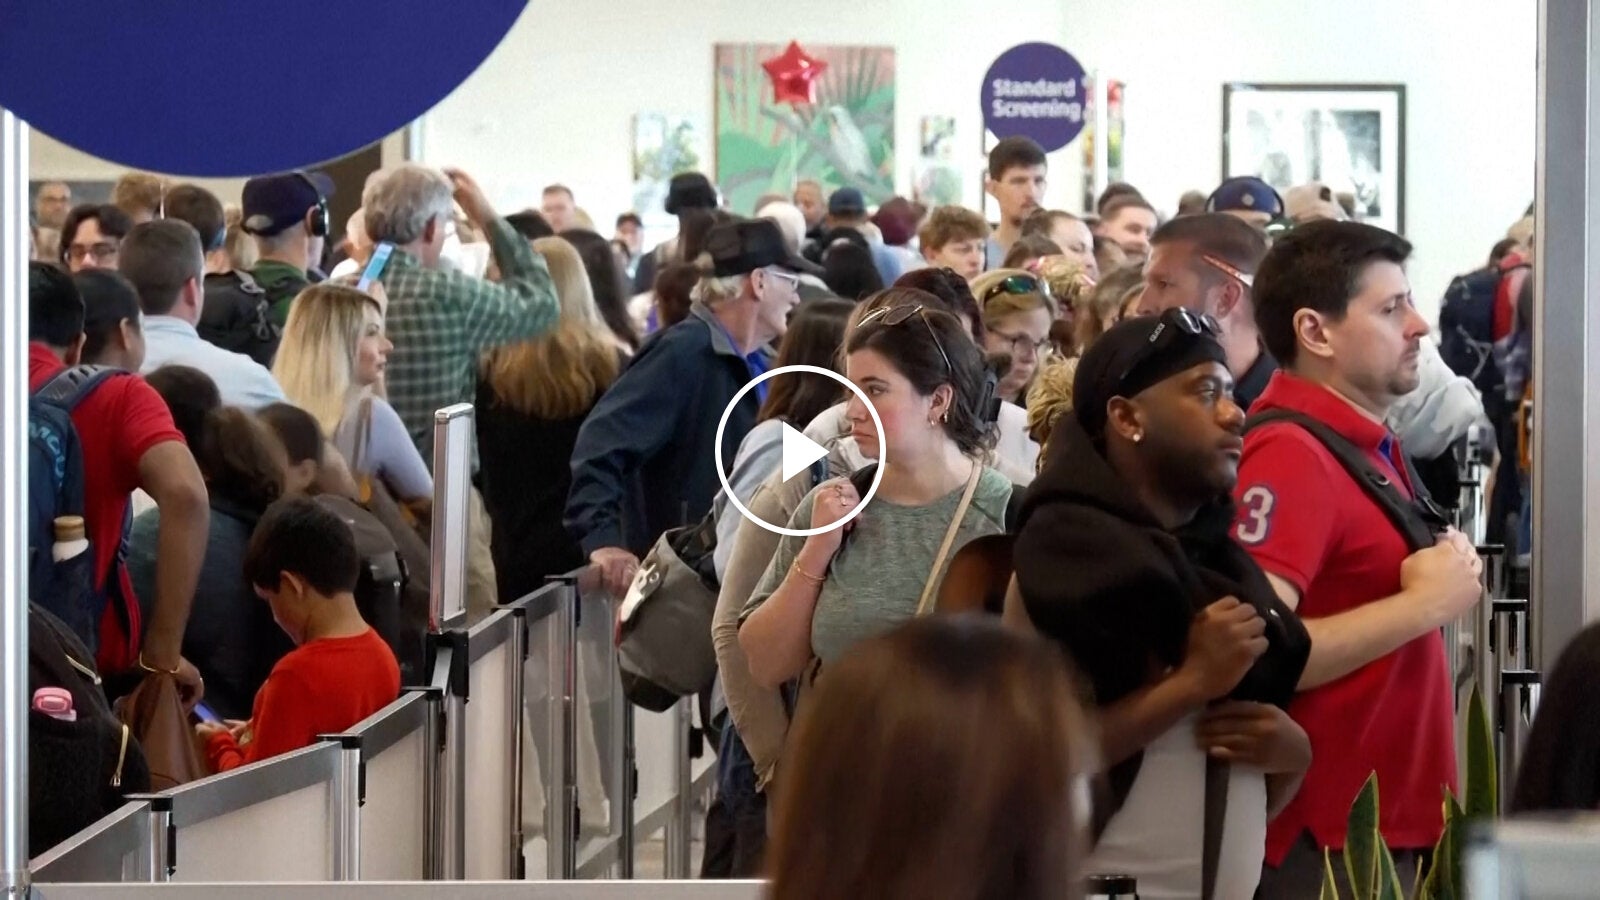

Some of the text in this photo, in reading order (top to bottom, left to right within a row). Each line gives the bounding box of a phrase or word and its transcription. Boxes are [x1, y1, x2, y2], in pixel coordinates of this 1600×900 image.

[993, 78, 1076, 97] Standard
[992, 98, 1081, 122] Screening
[1236, 485, 1275, 544] 3
